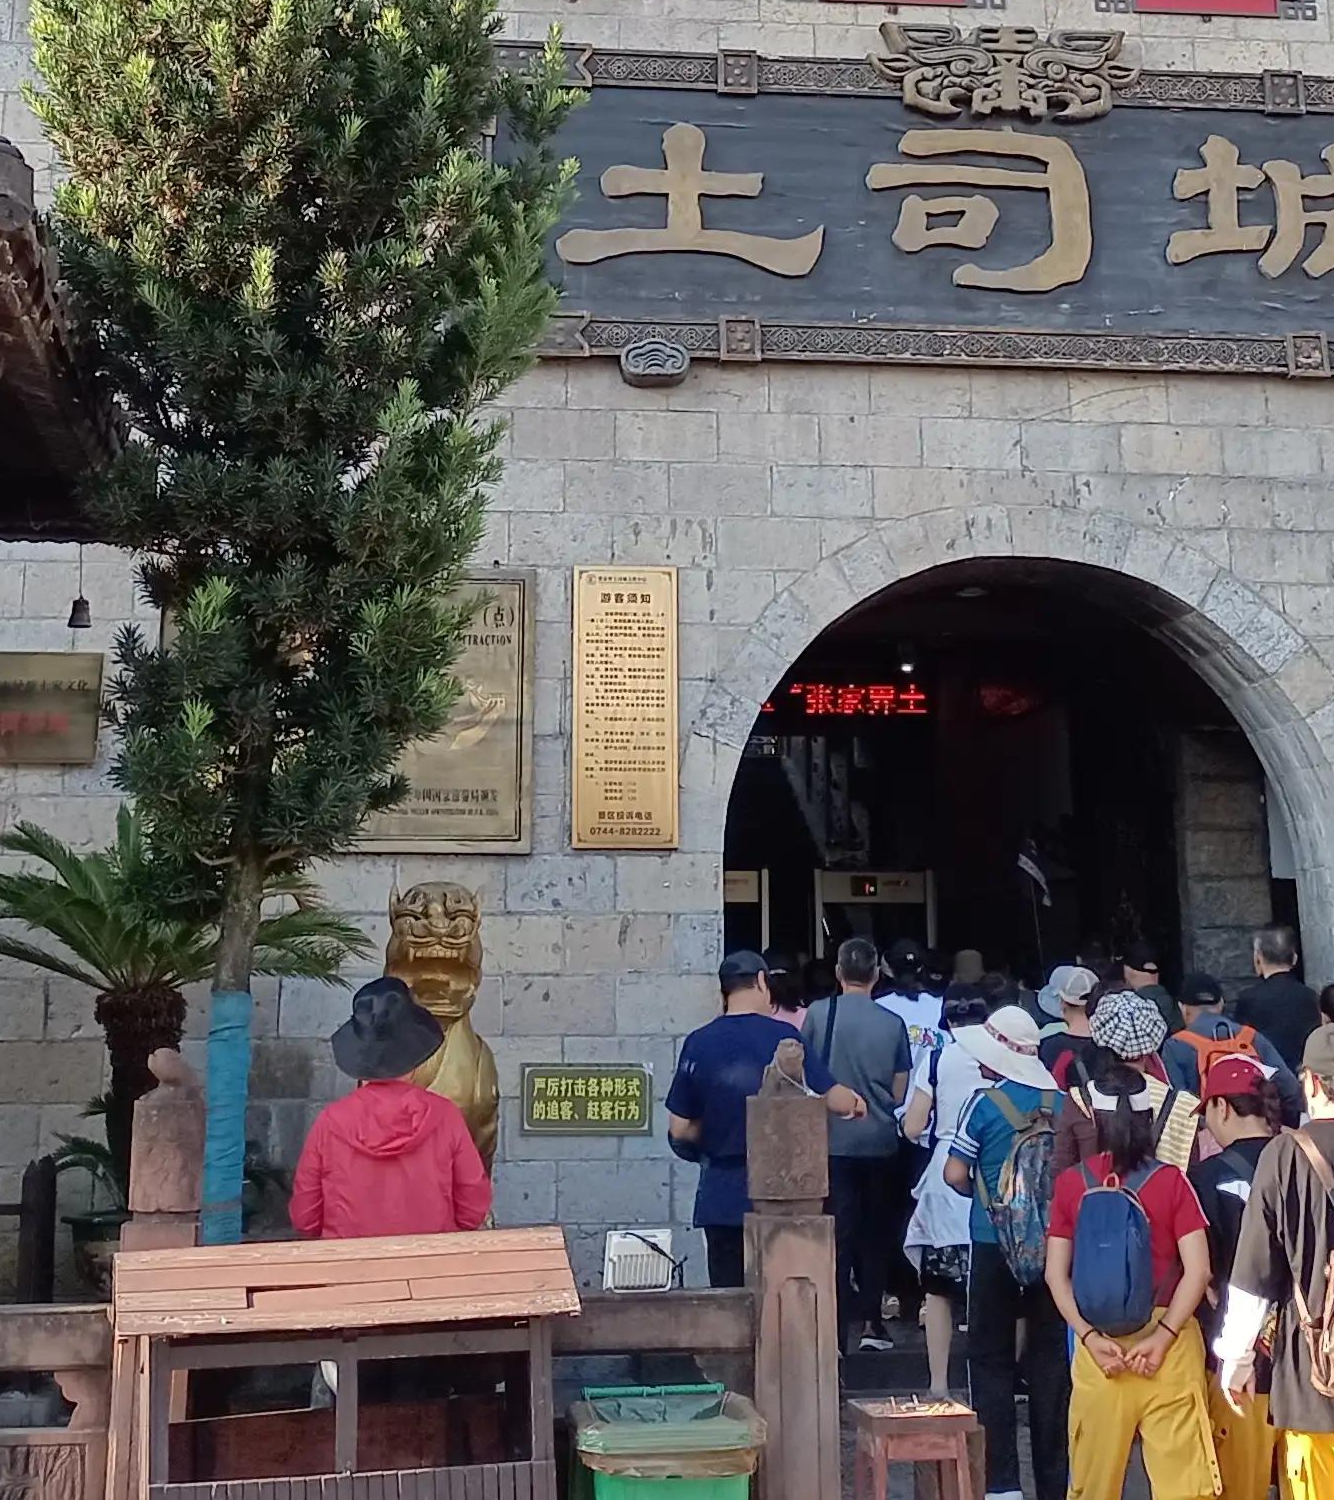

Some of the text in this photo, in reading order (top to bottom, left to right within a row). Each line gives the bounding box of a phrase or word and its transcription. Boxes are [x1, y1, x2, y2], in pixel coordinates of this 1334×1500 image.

[600, 592, 651, 604] 游客须知
[533, 1077, 640, 1097] 严厉打击各种形式
[533, 1101, 640, 1121] 的追客、赶客行为
